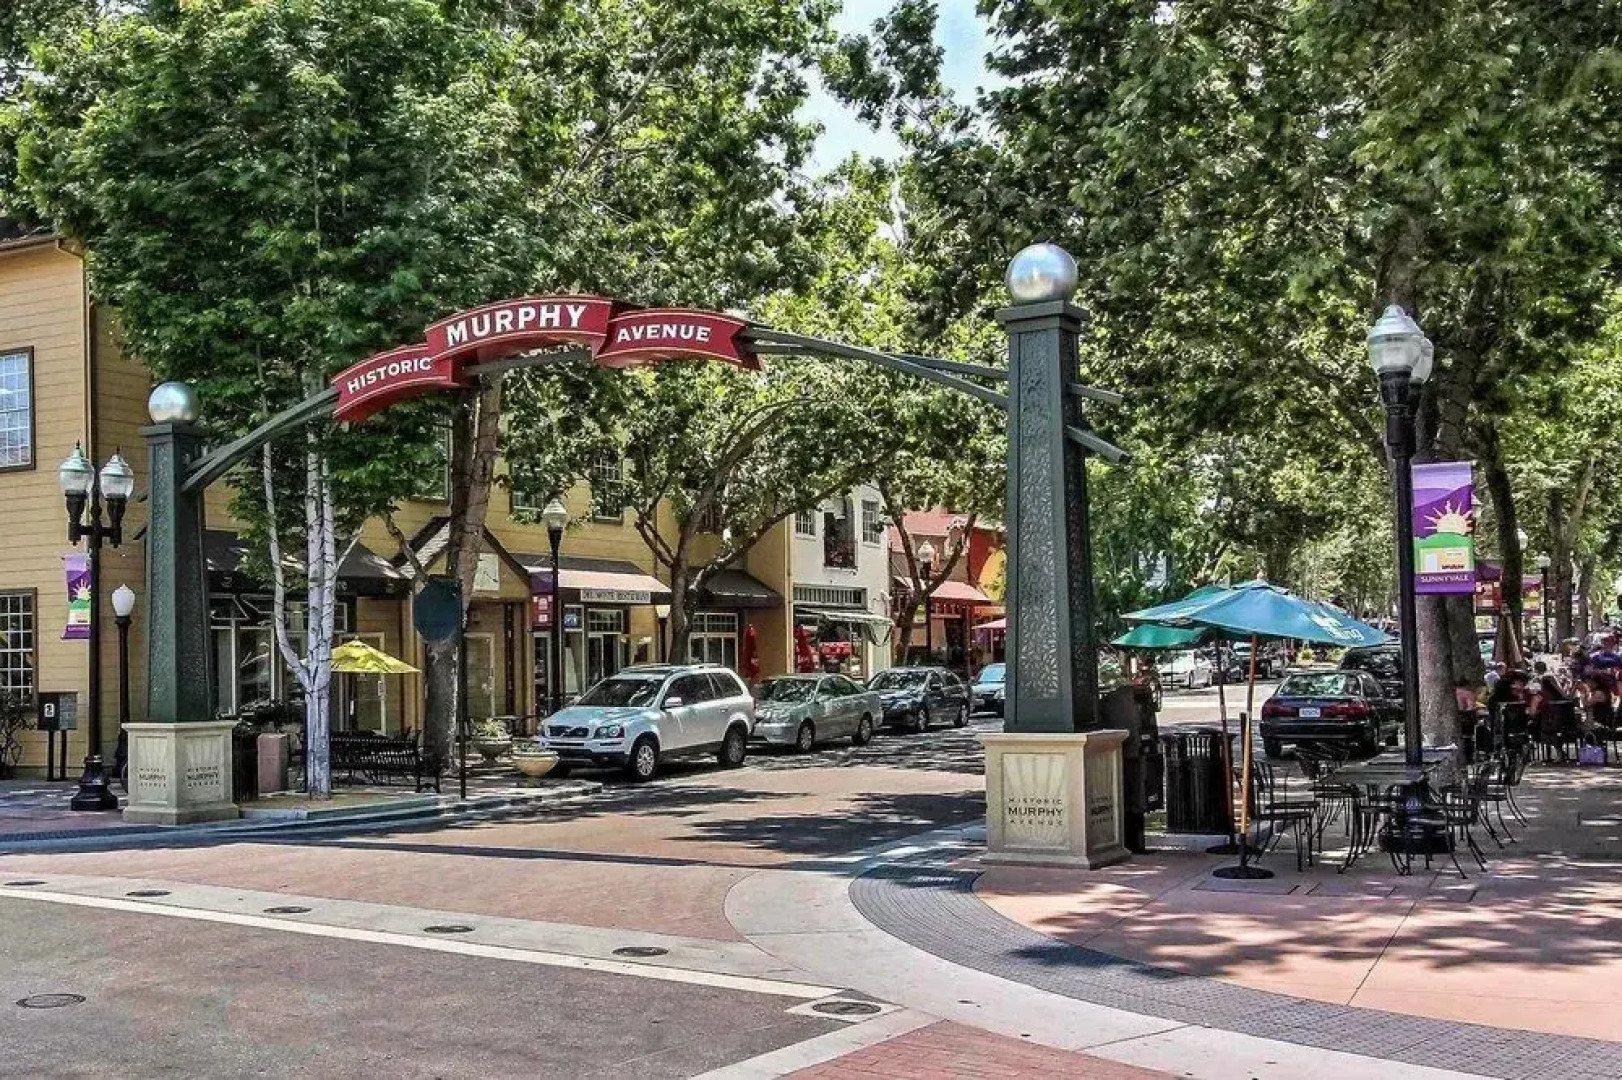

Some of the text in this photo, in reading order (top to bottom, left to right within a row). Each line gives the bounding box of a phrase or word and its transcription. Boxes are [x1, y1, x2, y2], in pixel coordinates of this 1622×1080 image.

[346, 304, 712, 395] HISTORIC MURPHY AVENUE
[1420, 574, 1470, 583] SUNNYVALE
[1008, 797, 1062, 805] HISTORIC
[1008, 807, 1063, 817] MURPHY
